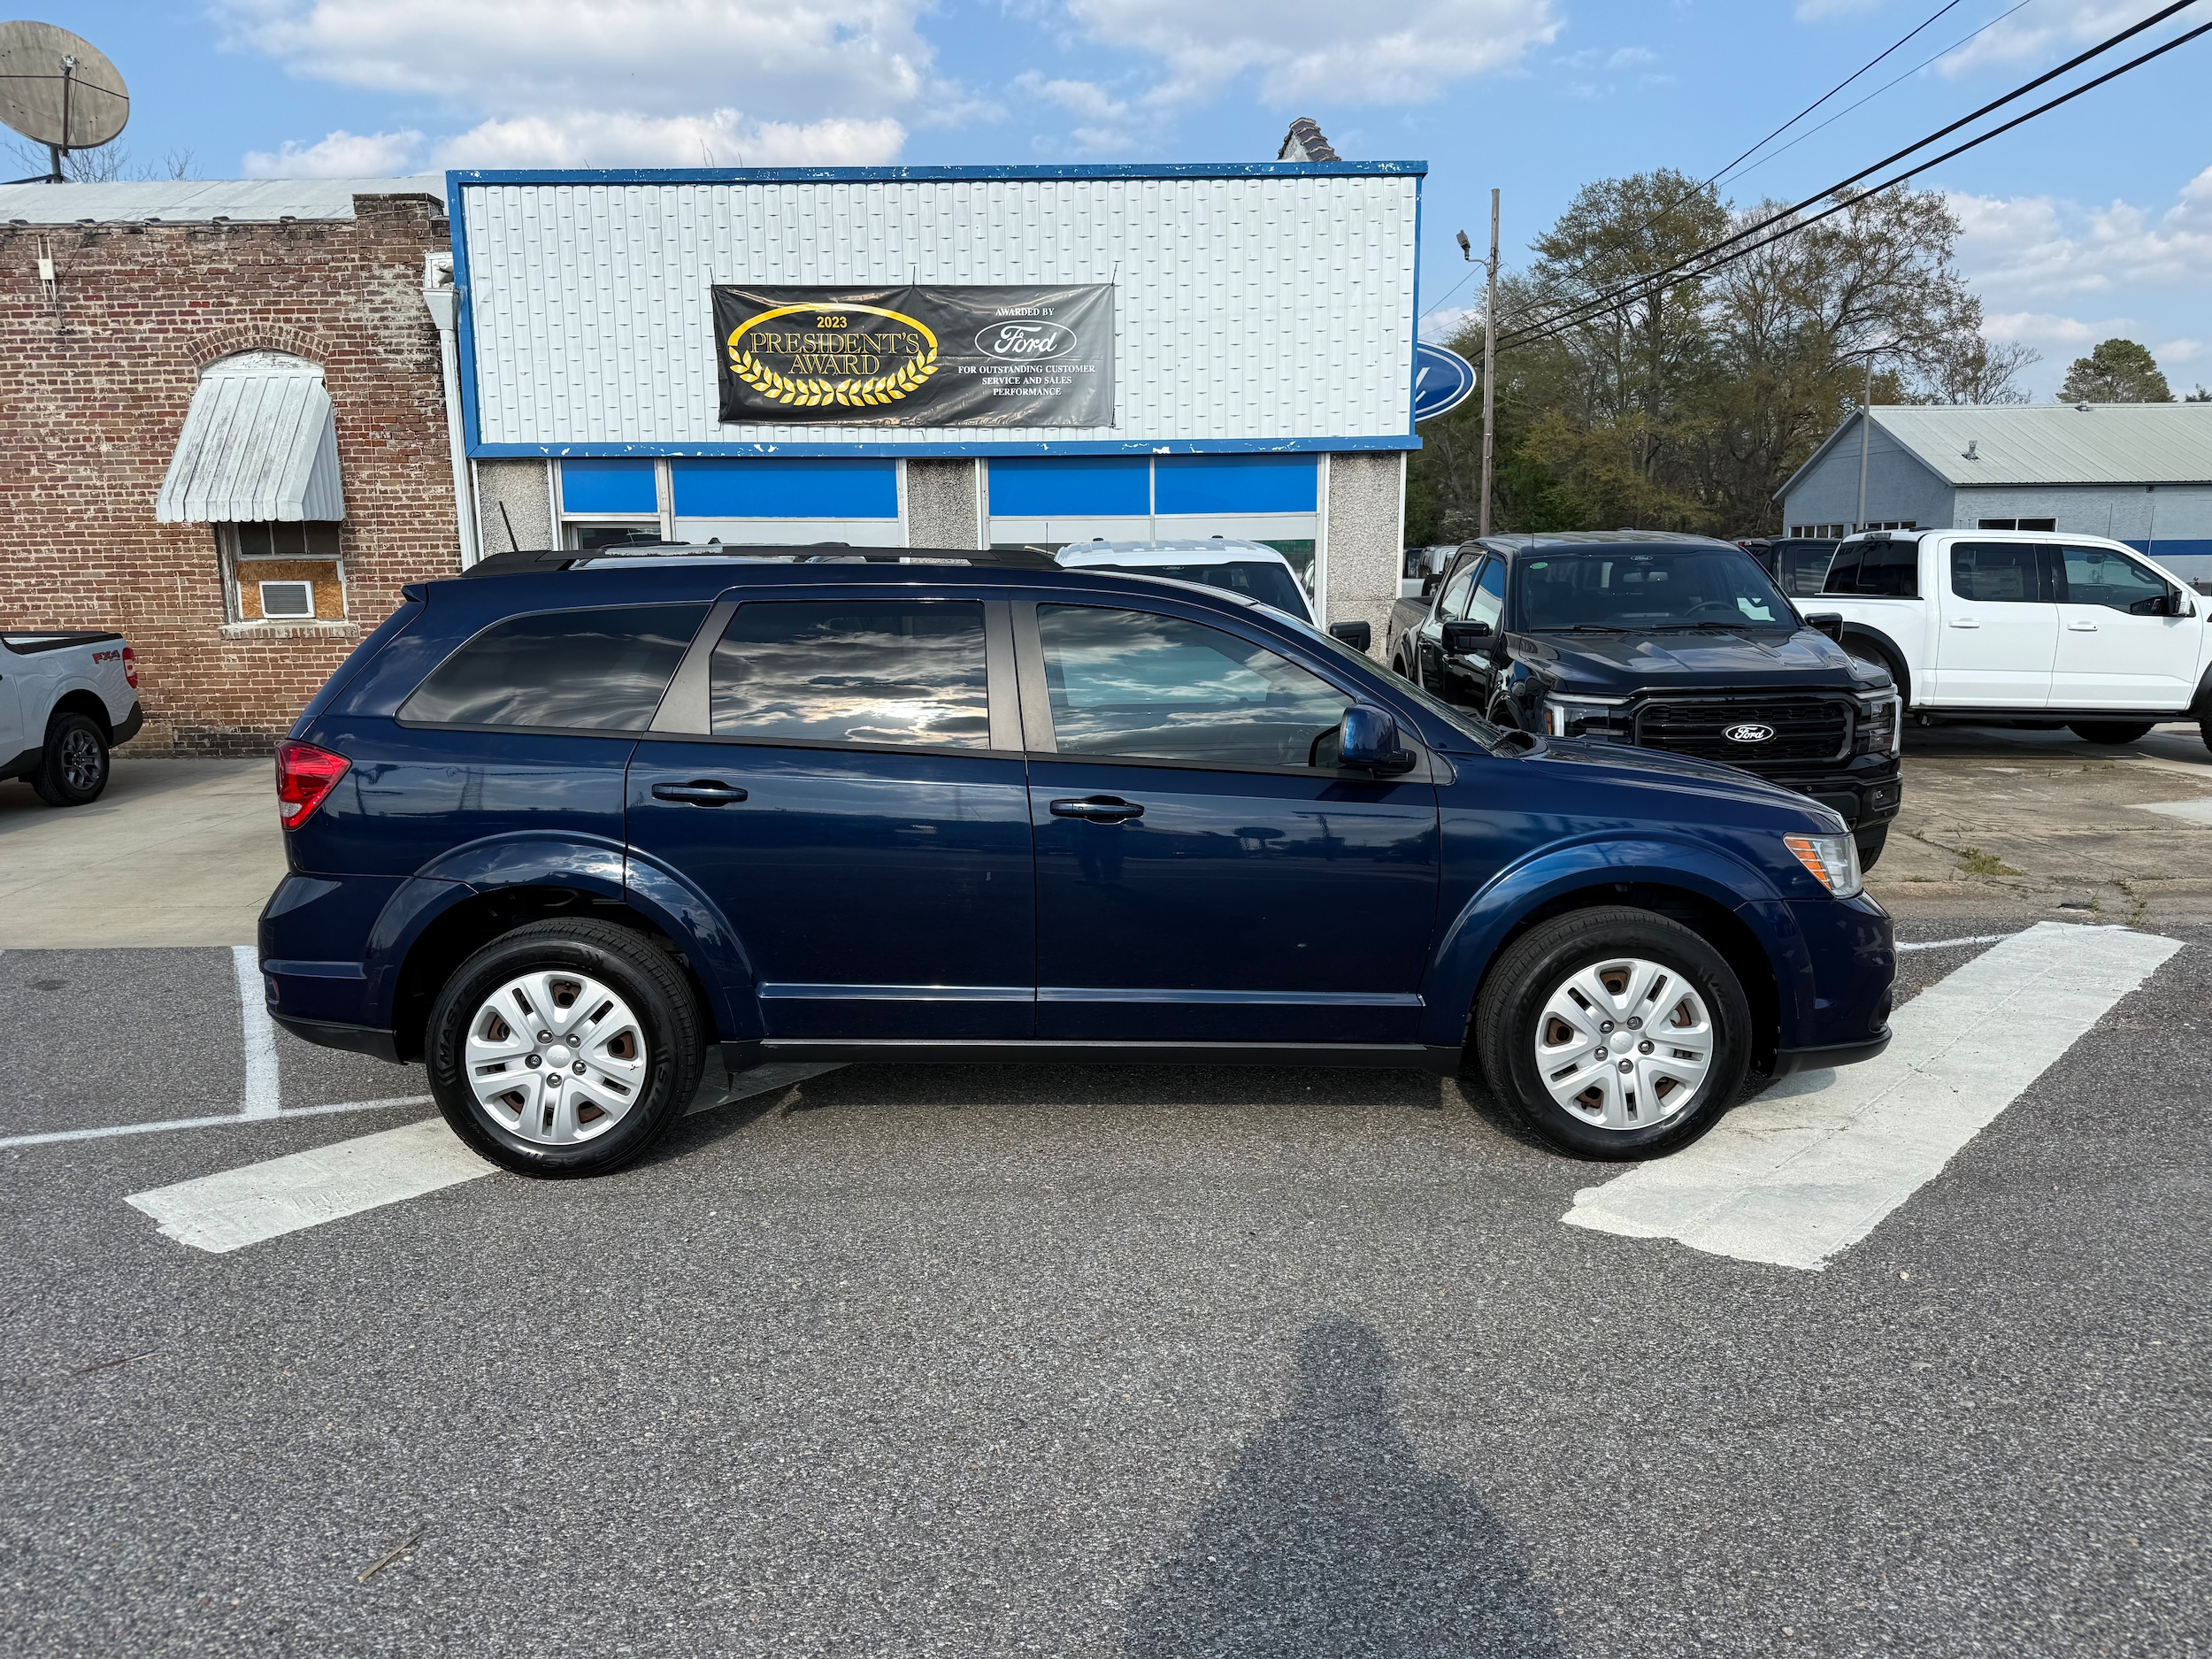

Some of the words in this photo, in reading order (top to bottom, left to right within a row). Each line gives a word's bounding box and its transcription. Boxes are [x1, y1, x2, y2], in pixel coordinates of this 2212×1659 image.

[817, 316, 848, 328] 2023
[749, 333, 920, 354] PRESIDENT'S
[994, 326, 1057, 353] Ford
[787, 354, 880, 375] AWARD
[958, 365, 977, 374] FOR
[1046, 365, 1095, 373] CUSTOMER
[92, 649, 120, 664] FX4
[1734, 726, 1765, 739] Ford
